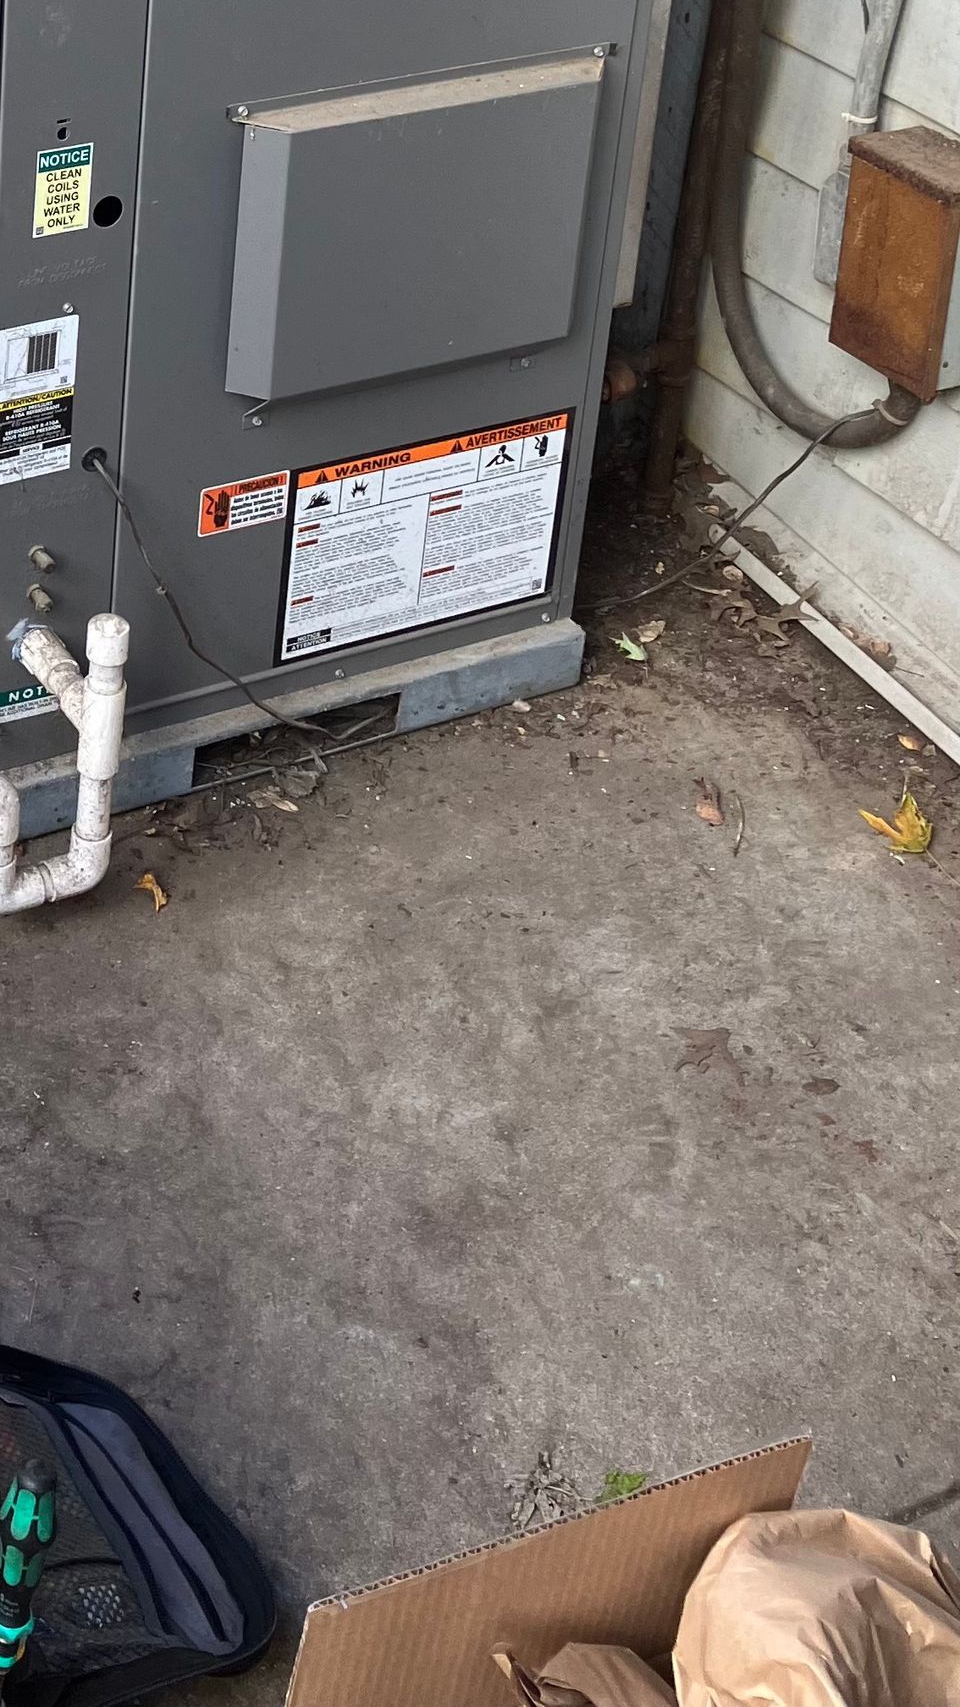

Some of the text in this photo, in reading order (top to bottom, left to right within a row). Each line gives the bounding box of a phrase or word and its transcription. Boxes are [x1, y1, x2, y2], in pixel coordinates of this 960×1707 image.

[40, 149, 89, 168] NOTICE
[46, 168, 82, 182] CLEAN
[47, 180, 79, 194] COILS
[46, 191, 79, 205] USING
[43, 202, 80, 217] WATER
[47, 214, 75, 228] ONLY
[465, 417, 562, 448] AVERTISSEMENT
[335, 452, 411, 478] WARNING
[291, 637, 327, 651] ATTENTION
